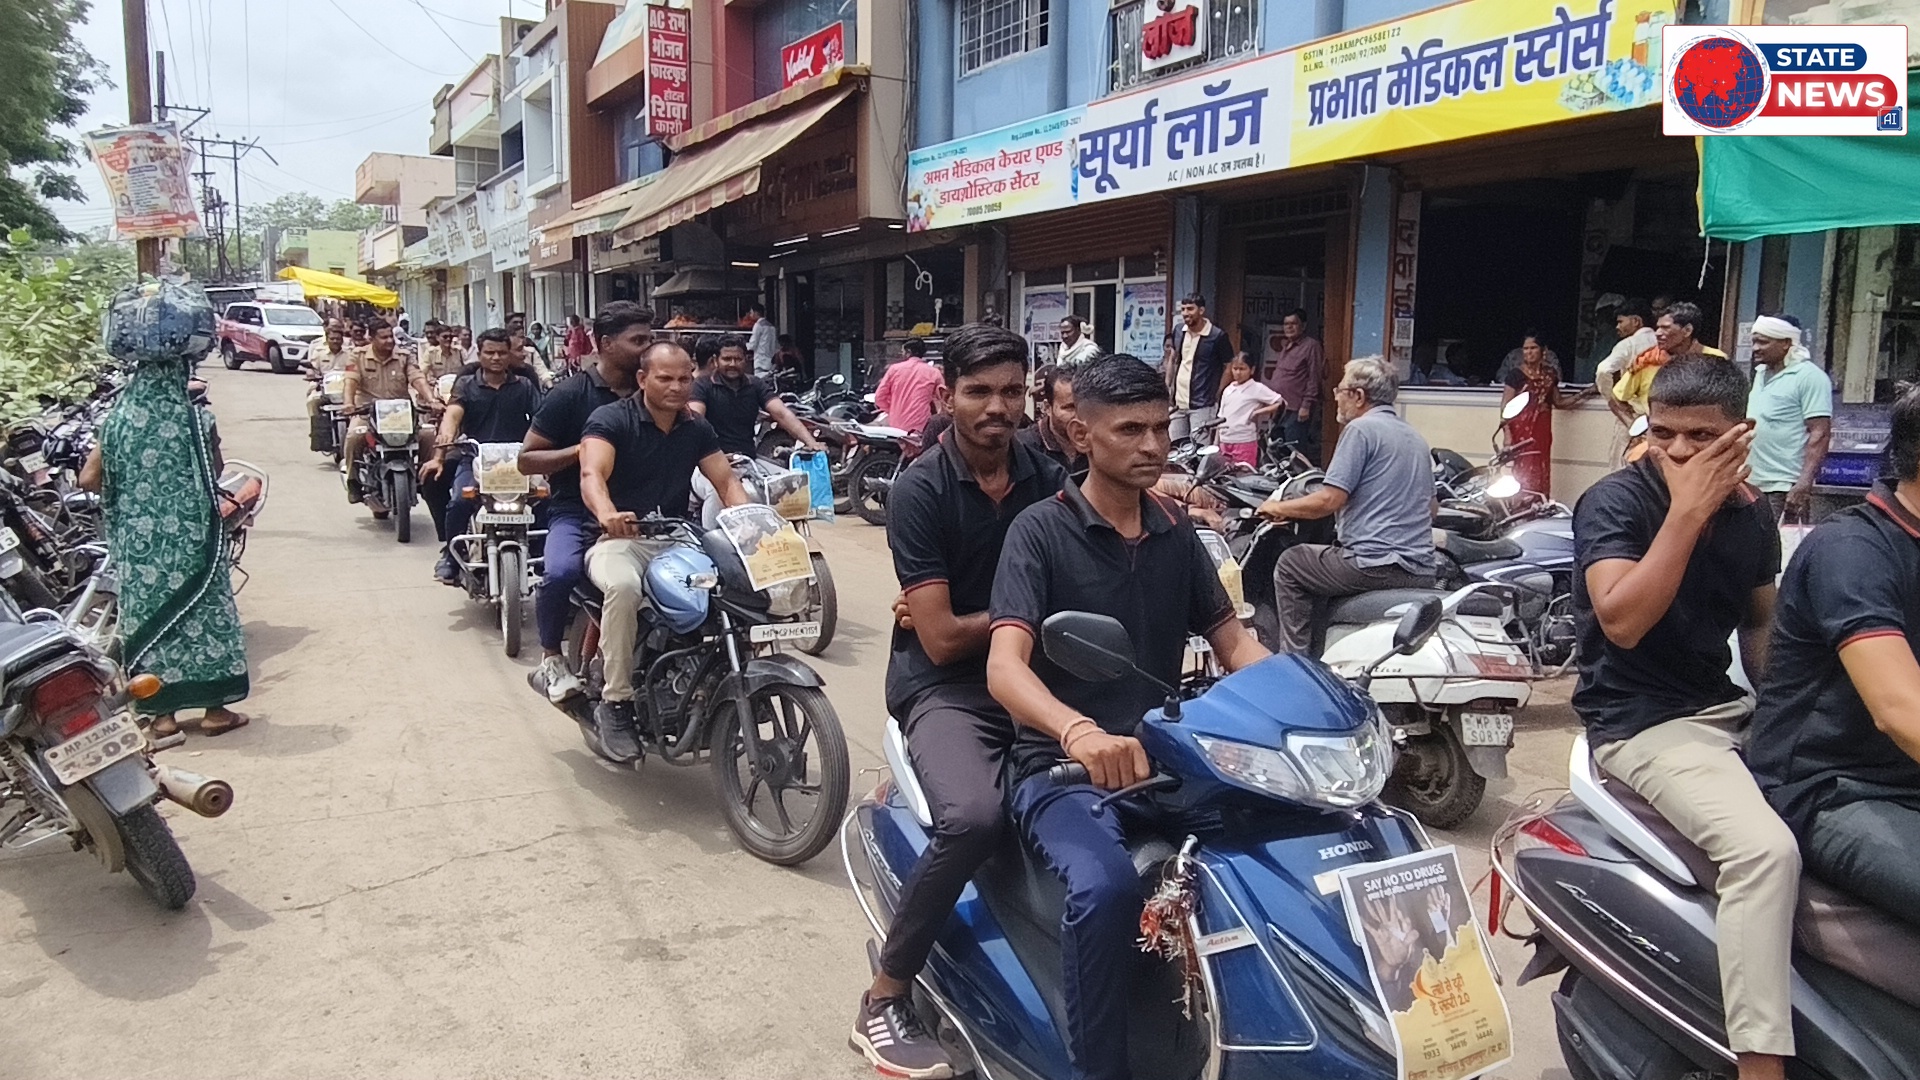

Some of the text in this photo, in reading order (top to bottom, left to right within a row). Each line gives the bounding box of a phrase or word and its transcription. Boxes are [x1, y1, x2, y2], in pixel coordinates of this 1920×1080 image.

[650, 9, 665, 30] AC
[652, 34, 684, 60] भोजन
[1303, 48, 1324, 61] GSTIN
[1308, 0, 1612, 127] प्रभात मेडिकल स्टोर्स
[1079, 79, 1269, 194] सूर्या लॉज
[923, 140, 1063, 185] अमन मेडिकल केयर एण्ड
[1168, 170, 1178, 182] AC
[1186, 165, 1205, 179] NON
[1207, 162, 1218, 175] AC
[1010, 170, 1041, 190] सेंटर
[1476, 716, 1489, 729] MP
[1318, 840, 1374, 860] HONDA
[1363, 878, 1382, 893] SAY
[1383, 873, 1399, 887] NO
[1398, 870, 1413, 883] TO
[1413, 863, 1445, 880] DRUGS
[1206, 934, 1239, 947] Activa
[1423, 1048, 1441, 1060] 1933
